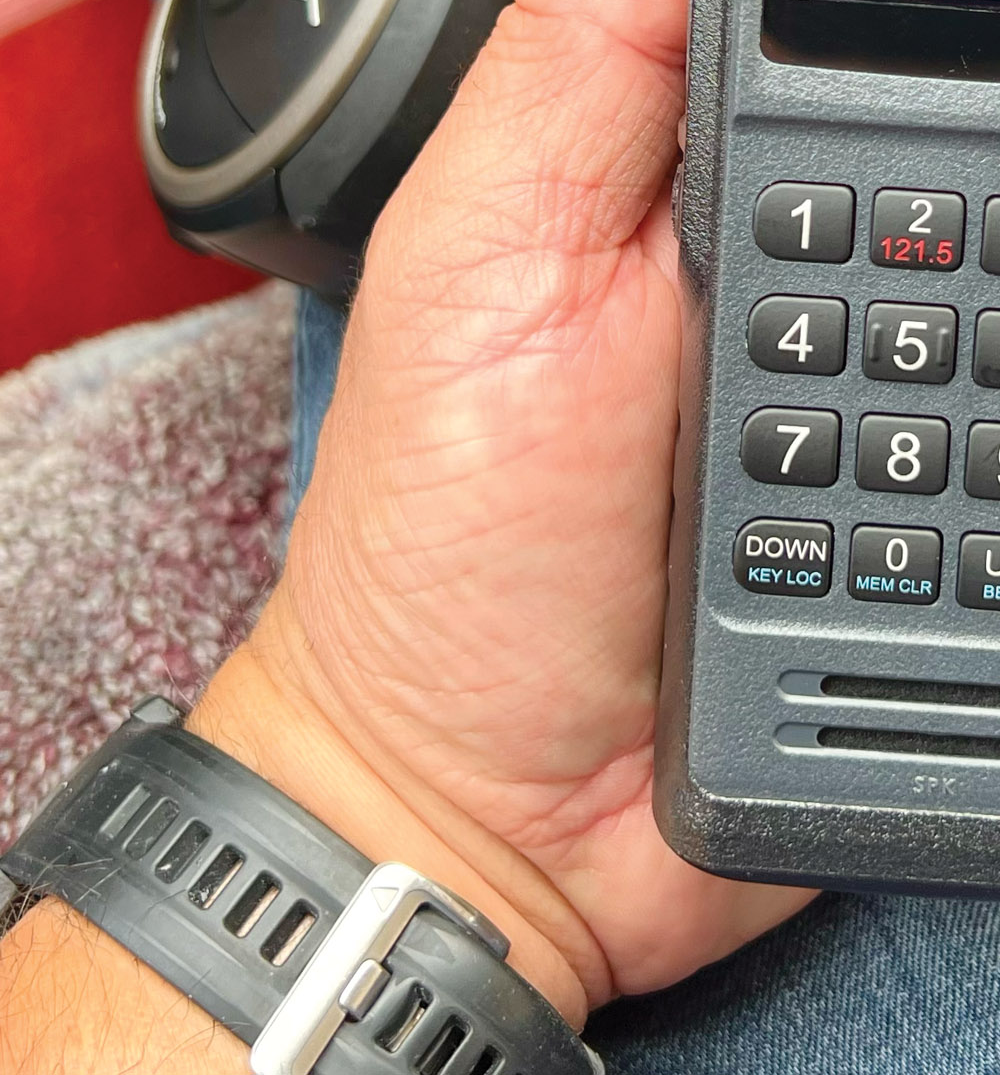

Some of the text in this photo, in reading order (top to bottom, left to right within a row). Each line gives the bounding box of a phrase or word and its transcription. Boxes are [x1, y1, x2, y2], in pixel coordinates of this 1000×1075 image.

[790, 199, 812, 251] 1
[909, 199, 932, 233] 2
[881, 237, 953, 264] 121.5
[777, 313, 813, 363] 4
[892, 321, 928, 371] 5
[776, 424, 810, 474] 7
[886, 431, 921, 482] 8
[745, 535, 826, 562] DOWN
[886, 538, 908, 571] 0
[748, 567, 821, 587] KEY LOC
[856, 576, 932, 595] MEM CLR
[912, 776, 956, 795] SPK
